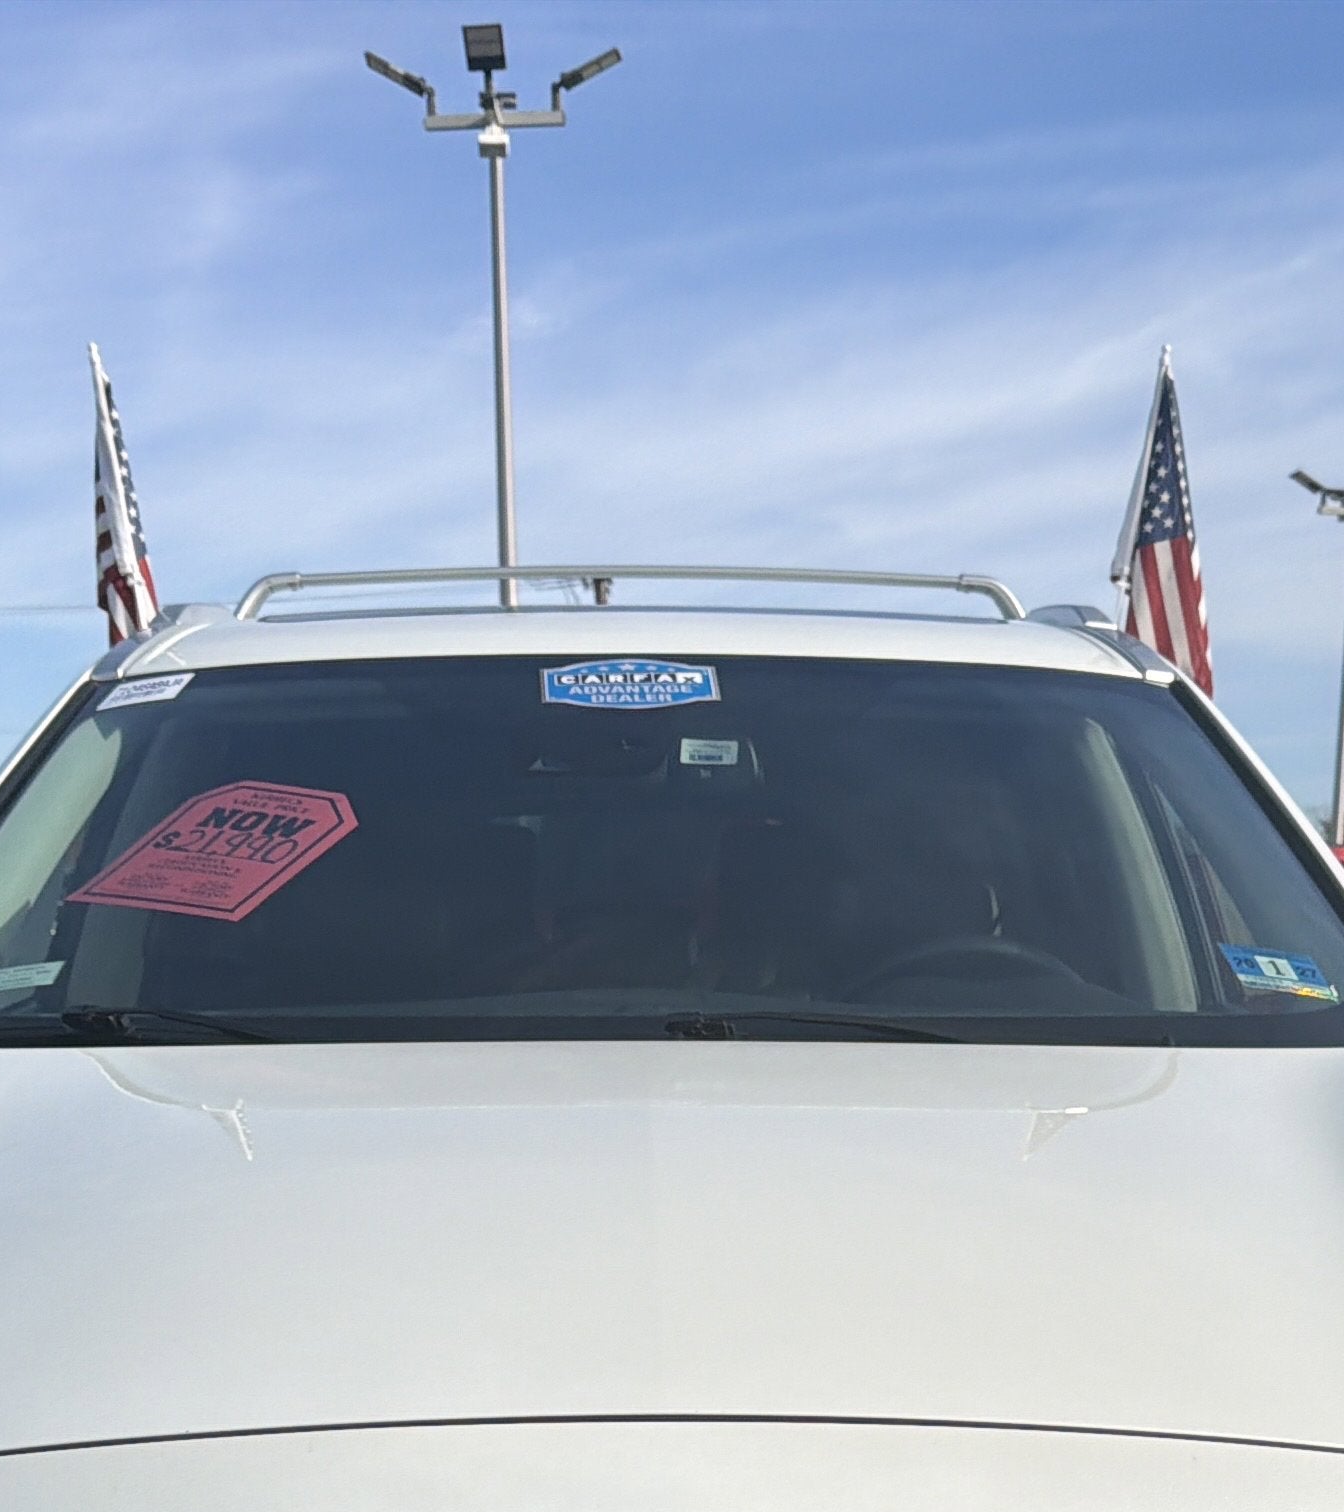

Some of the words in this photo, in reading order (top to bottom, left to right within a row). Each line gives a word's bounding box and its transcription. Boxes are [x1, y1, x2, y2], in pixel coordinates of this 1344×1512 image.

[558, 671, 703, 685] CARFAX
[568, 685, 692, 695] ADVANTAGE
[590, 694, 673, 704] DEALER
[196, 807, 316, 838] NOW
